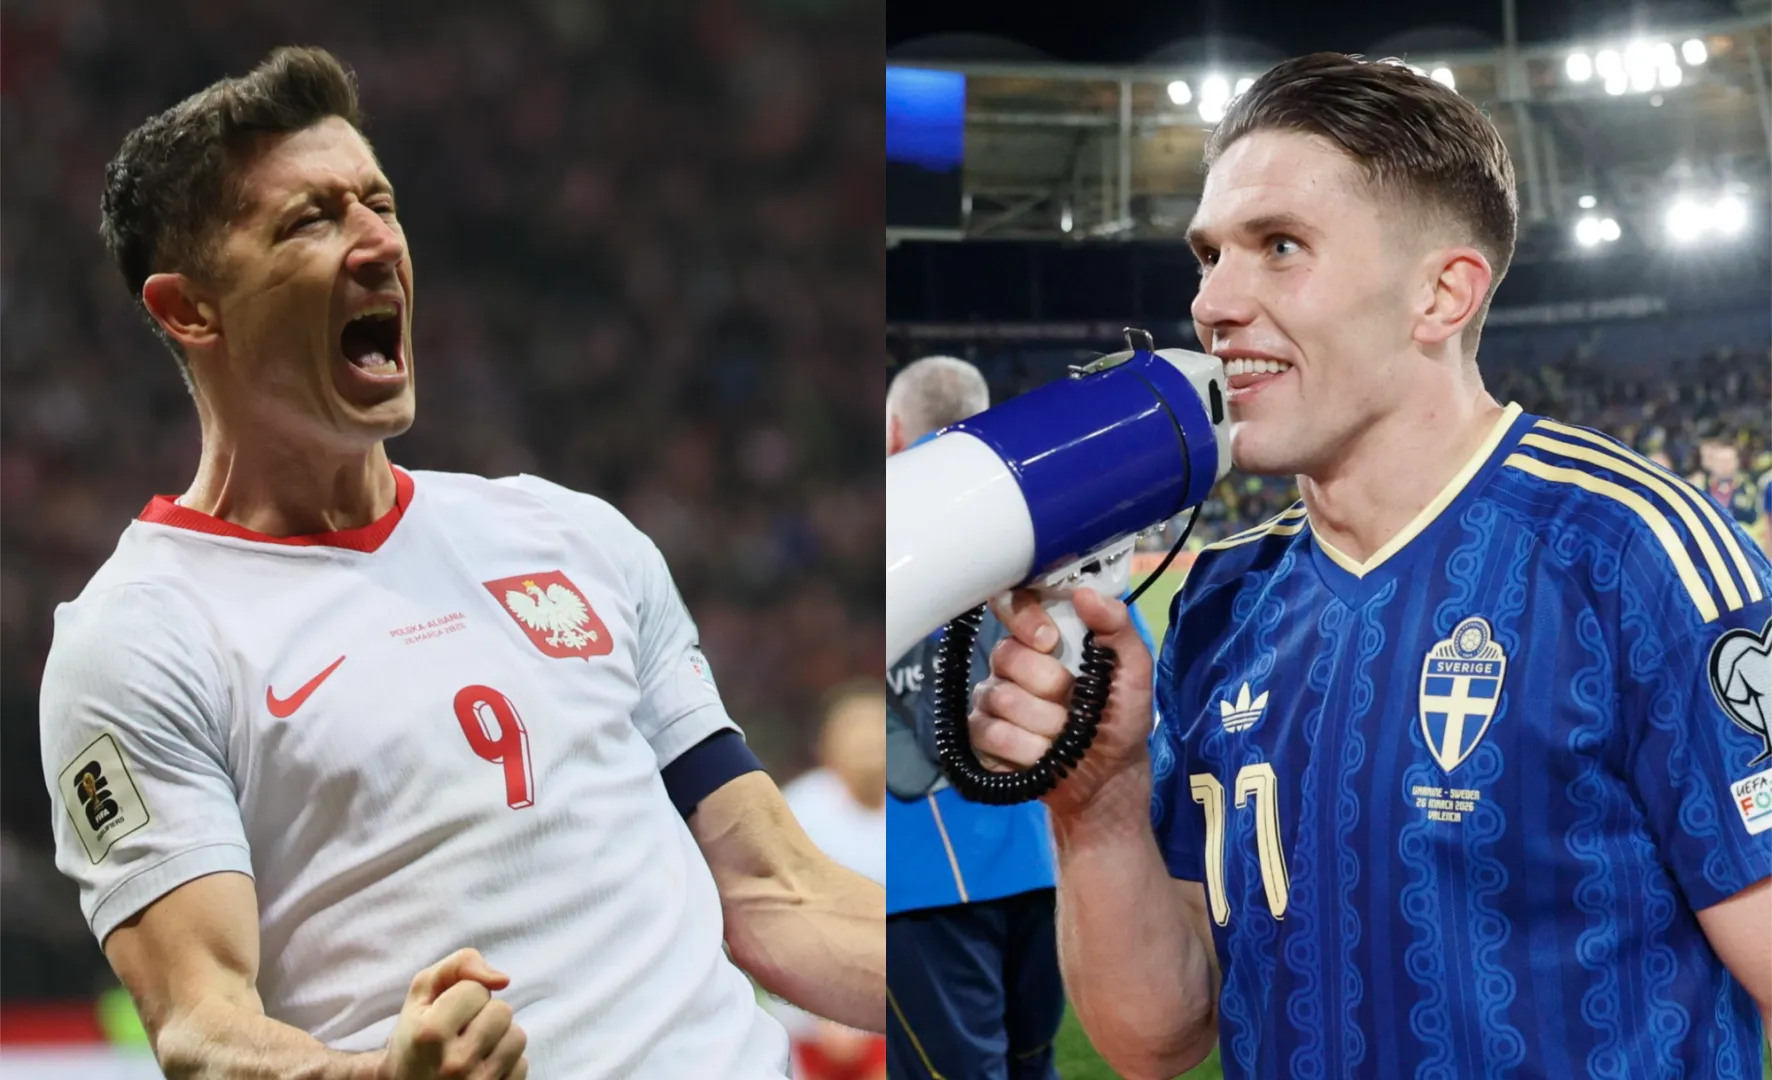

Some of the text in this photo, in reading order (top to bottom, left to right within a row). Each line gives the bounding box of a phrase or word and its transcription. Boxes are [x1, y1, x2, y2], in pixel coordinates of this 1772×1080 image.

[1436, 661, 1493, 674] SVERIGE
[453, 684, 535, 811] 9
[1735, 776, 1768, 797] UEFA
[1189, 762, 1291, 928] 17
